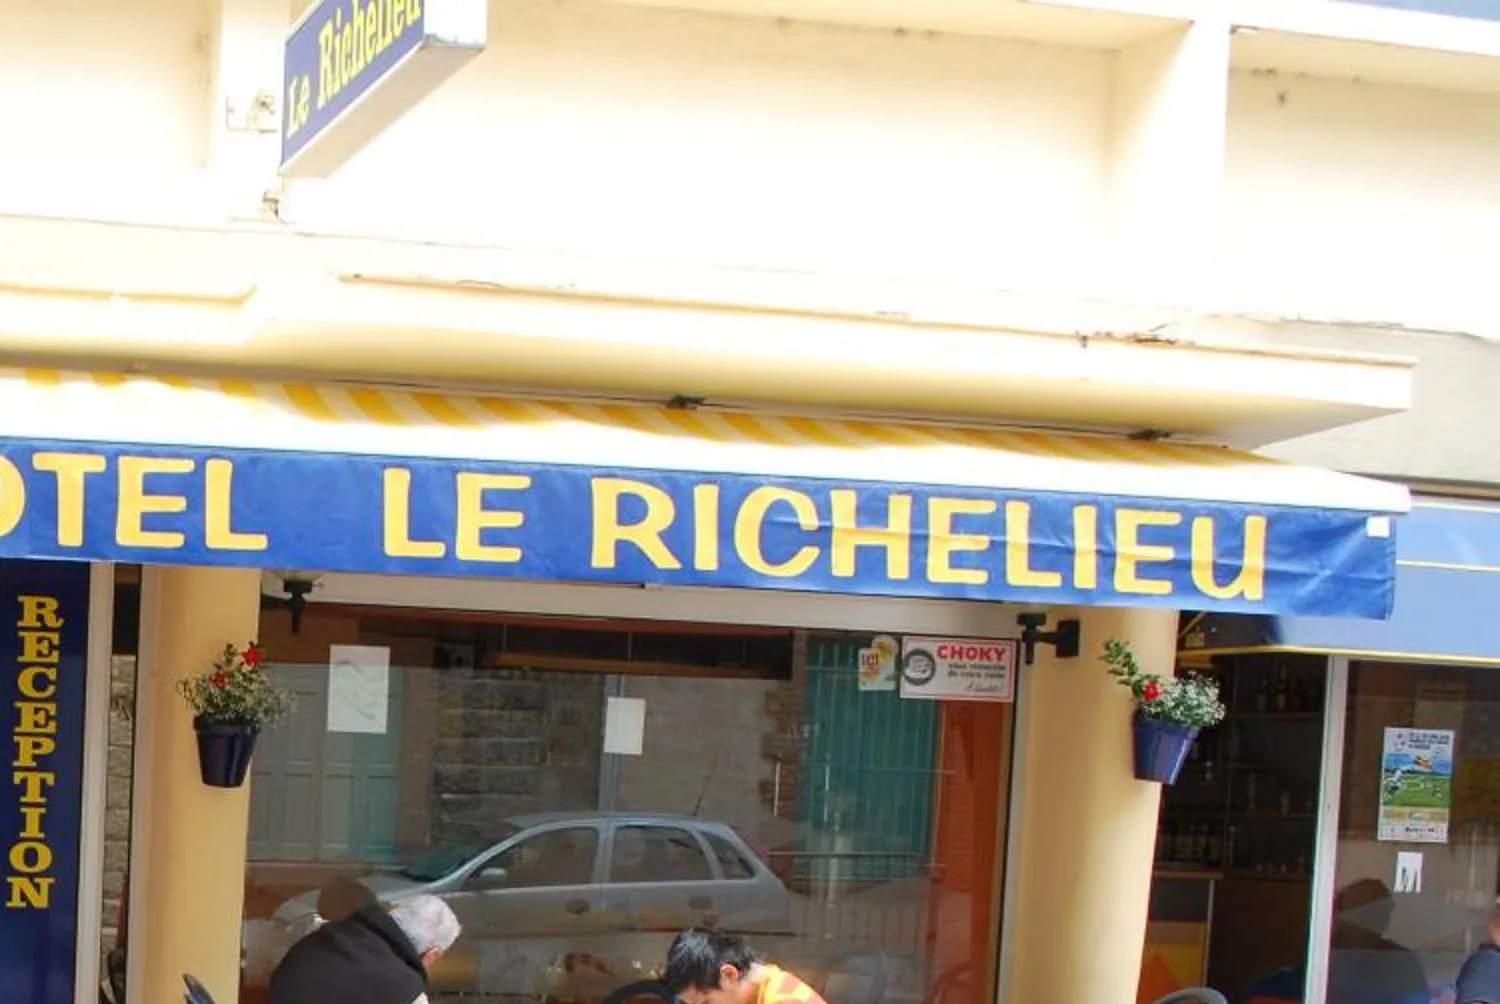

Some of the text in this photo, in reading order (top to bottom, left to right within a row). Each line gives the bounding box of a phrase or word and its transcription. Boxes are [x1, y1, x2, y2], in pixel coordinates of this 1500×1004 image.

[382, 467, 532, 564] LE
[590, 476, 1267, 601] RICHELIEU
[936, 645, 1007, 662] CHOKY
[5, 595, 65, 909] RECEPTION
